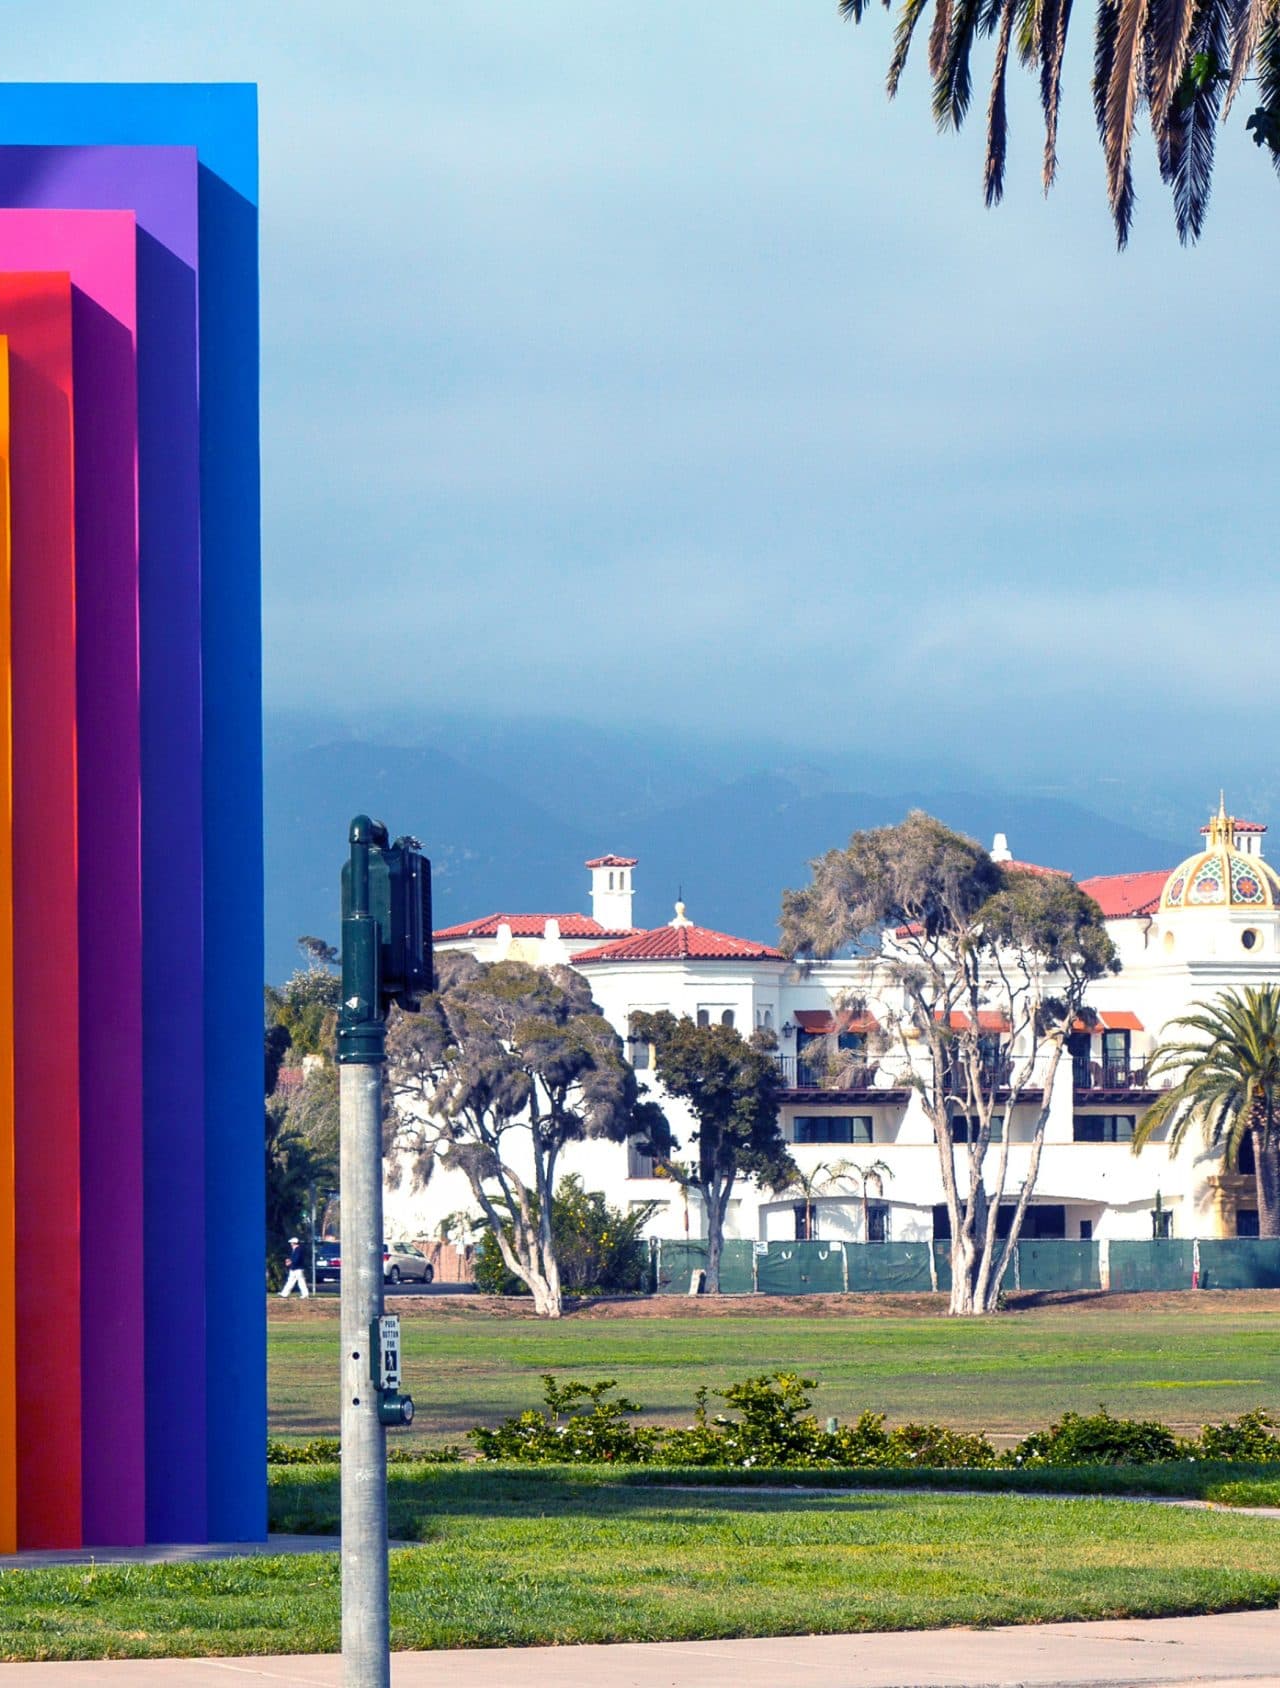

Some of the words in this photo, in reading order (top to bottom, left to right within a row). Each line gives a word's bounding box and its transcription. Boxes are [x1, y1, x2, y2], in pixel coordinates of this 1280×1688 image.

[384, 1320, 396, 1328] PUSH
[382, 1330, 399, 1338] BUTTON
[387, 1340, 395, 1348] FOR
